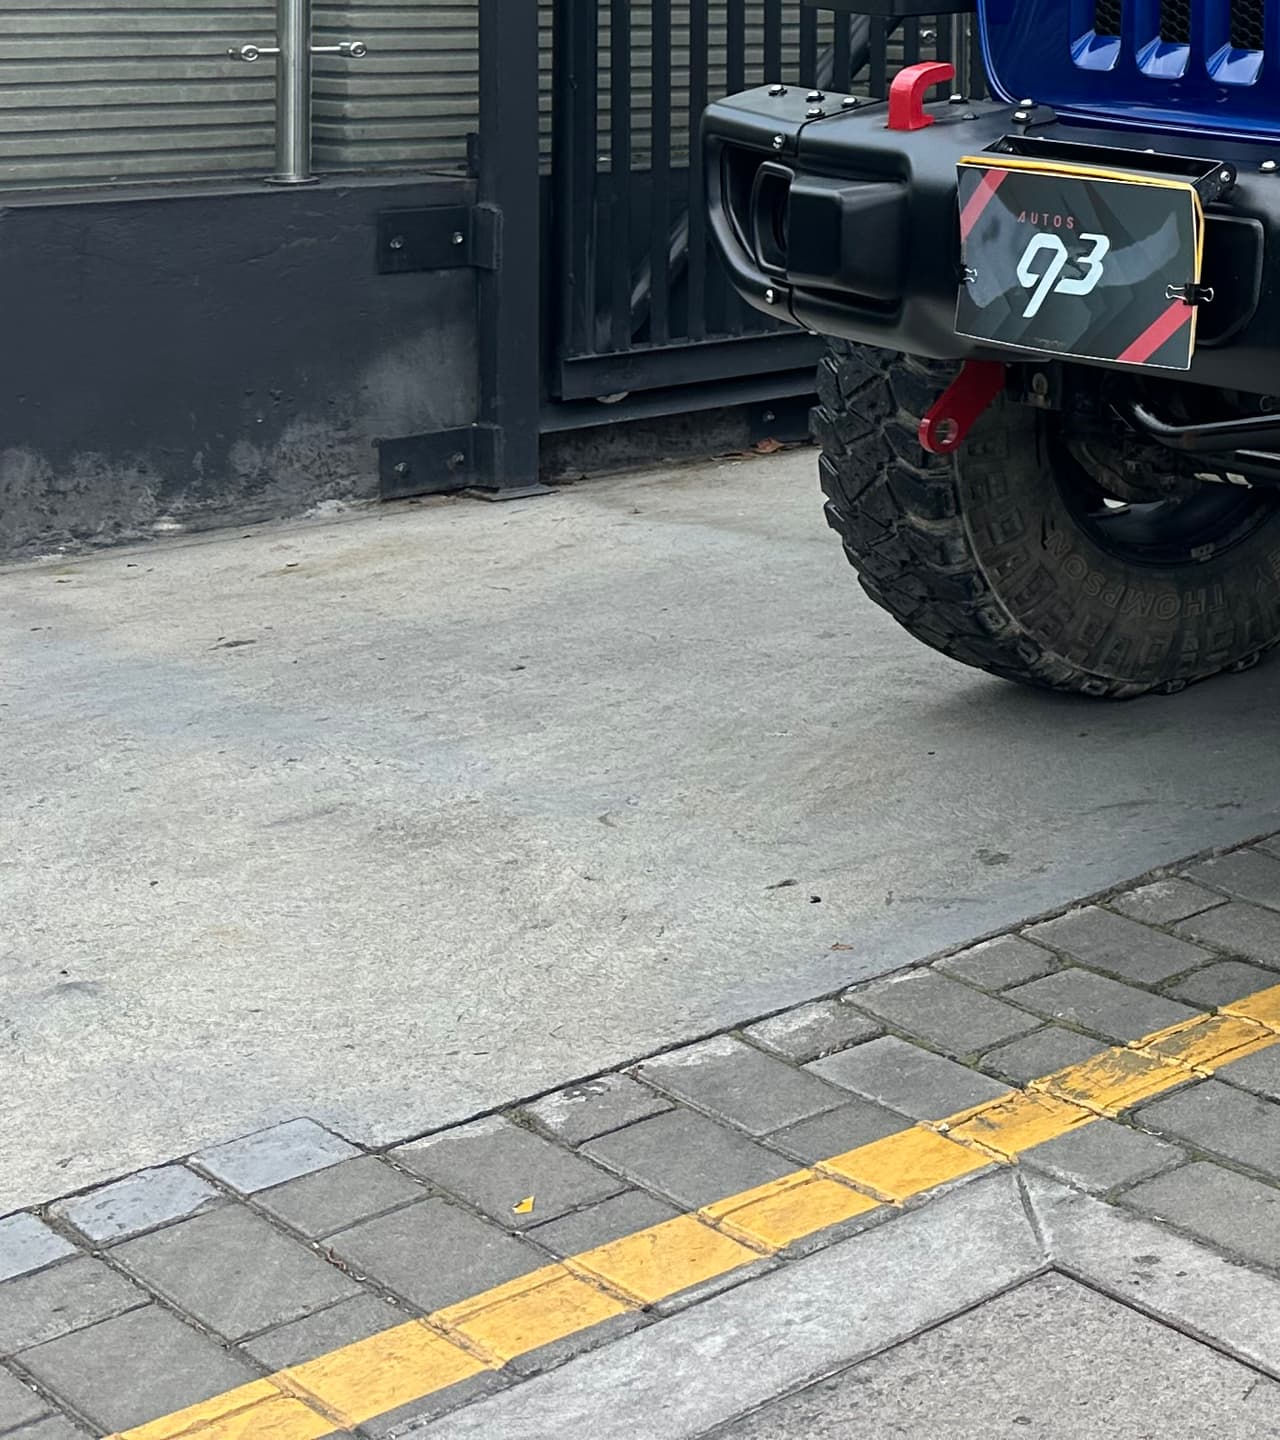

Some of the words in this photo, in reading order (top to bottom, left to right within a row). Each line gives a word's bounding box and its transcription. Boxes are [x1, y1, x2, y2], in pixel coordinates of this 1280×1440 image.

[1016, 210, 1077, 230] AUTOS
[1016, 232, 1110, 318] 93
[1044, 529, 1229, 621] THOMPSON
